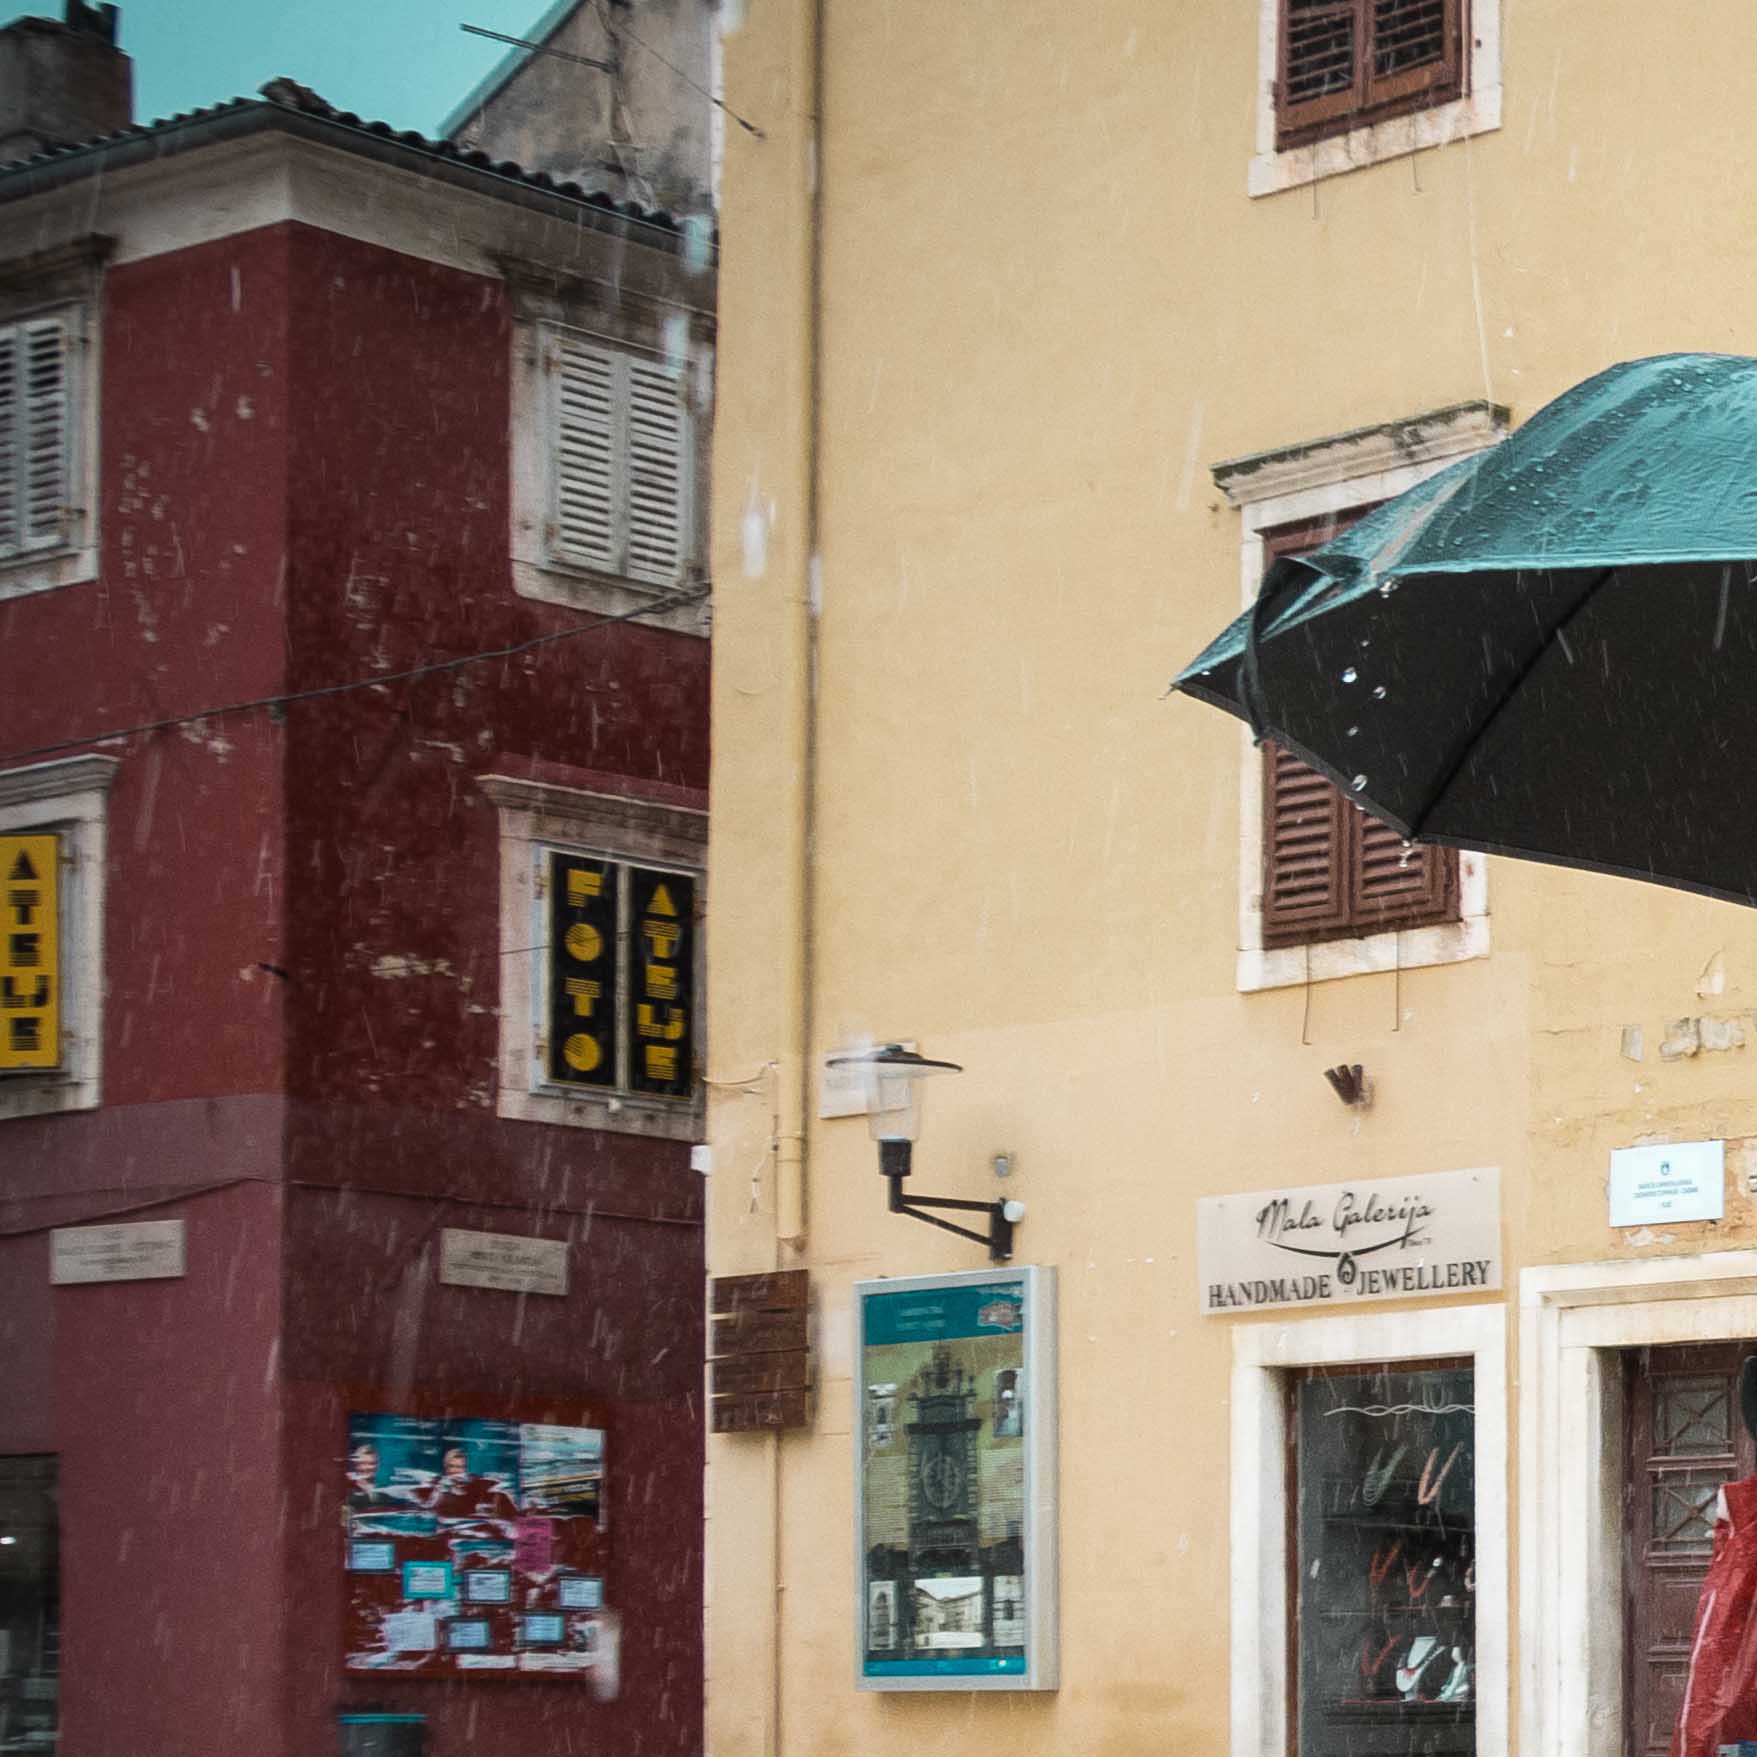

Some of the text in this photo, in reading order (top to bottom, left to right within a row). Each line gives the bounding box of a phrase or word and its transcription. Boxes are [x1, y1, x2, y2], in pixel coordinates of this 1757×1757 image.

[1, 849, 50, 1051] ATELJE
[564, 868, 604, 1073] FOTO
[637, 884, 686, 1081] ATELJE
[1208, 1260, 1491, 1308] HANDMADE JEWELLERY
[1256, 1191, 1436, 1249] Mala Galerija
